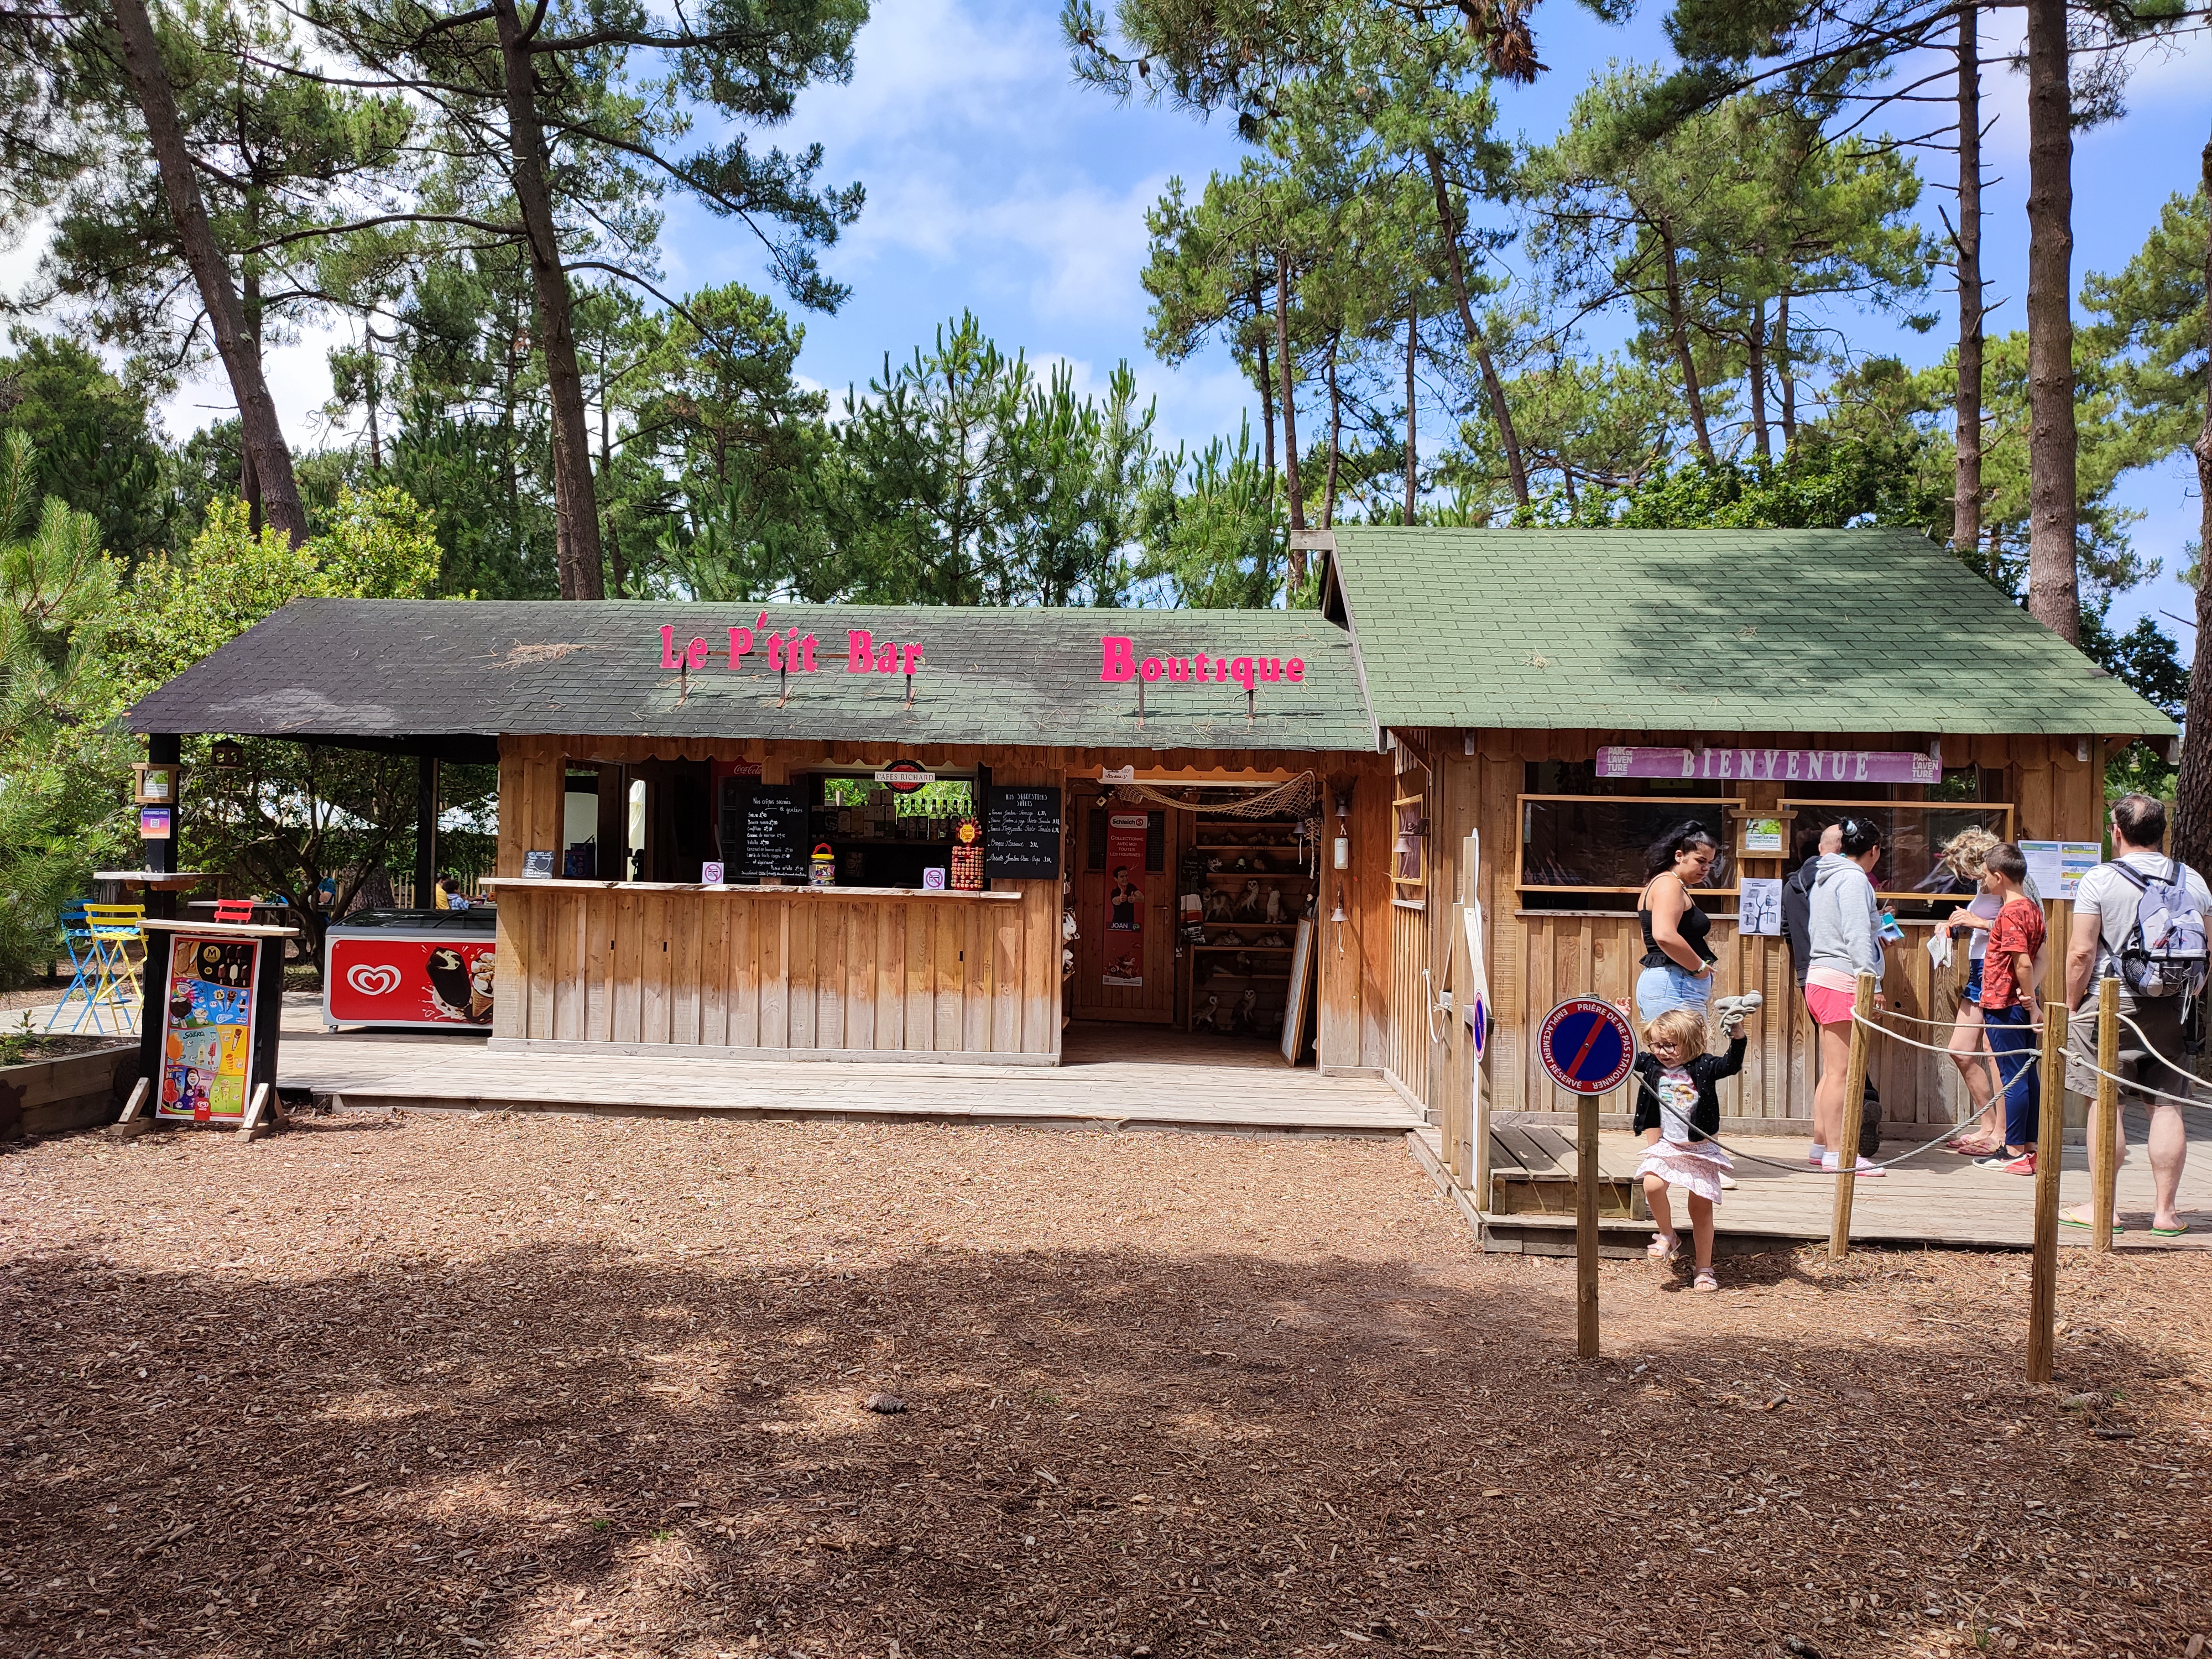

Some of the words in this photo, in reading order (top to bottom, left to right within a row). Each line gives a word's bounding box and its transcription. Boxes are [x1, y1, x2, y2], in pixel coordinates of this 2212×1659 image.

[658, 624, 708, 670] Le
[727, 609, 820, 672] P'tit
[847, 629, 924, 674] Bar
[1100, 636, 1305, 690] Boutique
[1608, 755, 1632, 764] L'AVEN
[1681, 749, 1870, 781] BIENVENUE
[1913, 761, 1939, 770] L'AVEN
[877, 772, 898, 780] CAFÉS
[900, 773, 934, 781] RICHARD
[1912, 770, 1933, 778] TURE
[1577, 1003, 1608, 1016] PRIÈRE
[1606, 1013, 1619, 1024] DE
[1542, 1008, 1568, 1063] EMPLACEMENT
[1615, 1022, 1627, 1035] NE
[1621, 1035, 1631, 1051] PAS
[1549, 1062, 1583, 1089] RÉSERVÉ
[1592, 1052, 1631, 1089] STATIONNER
